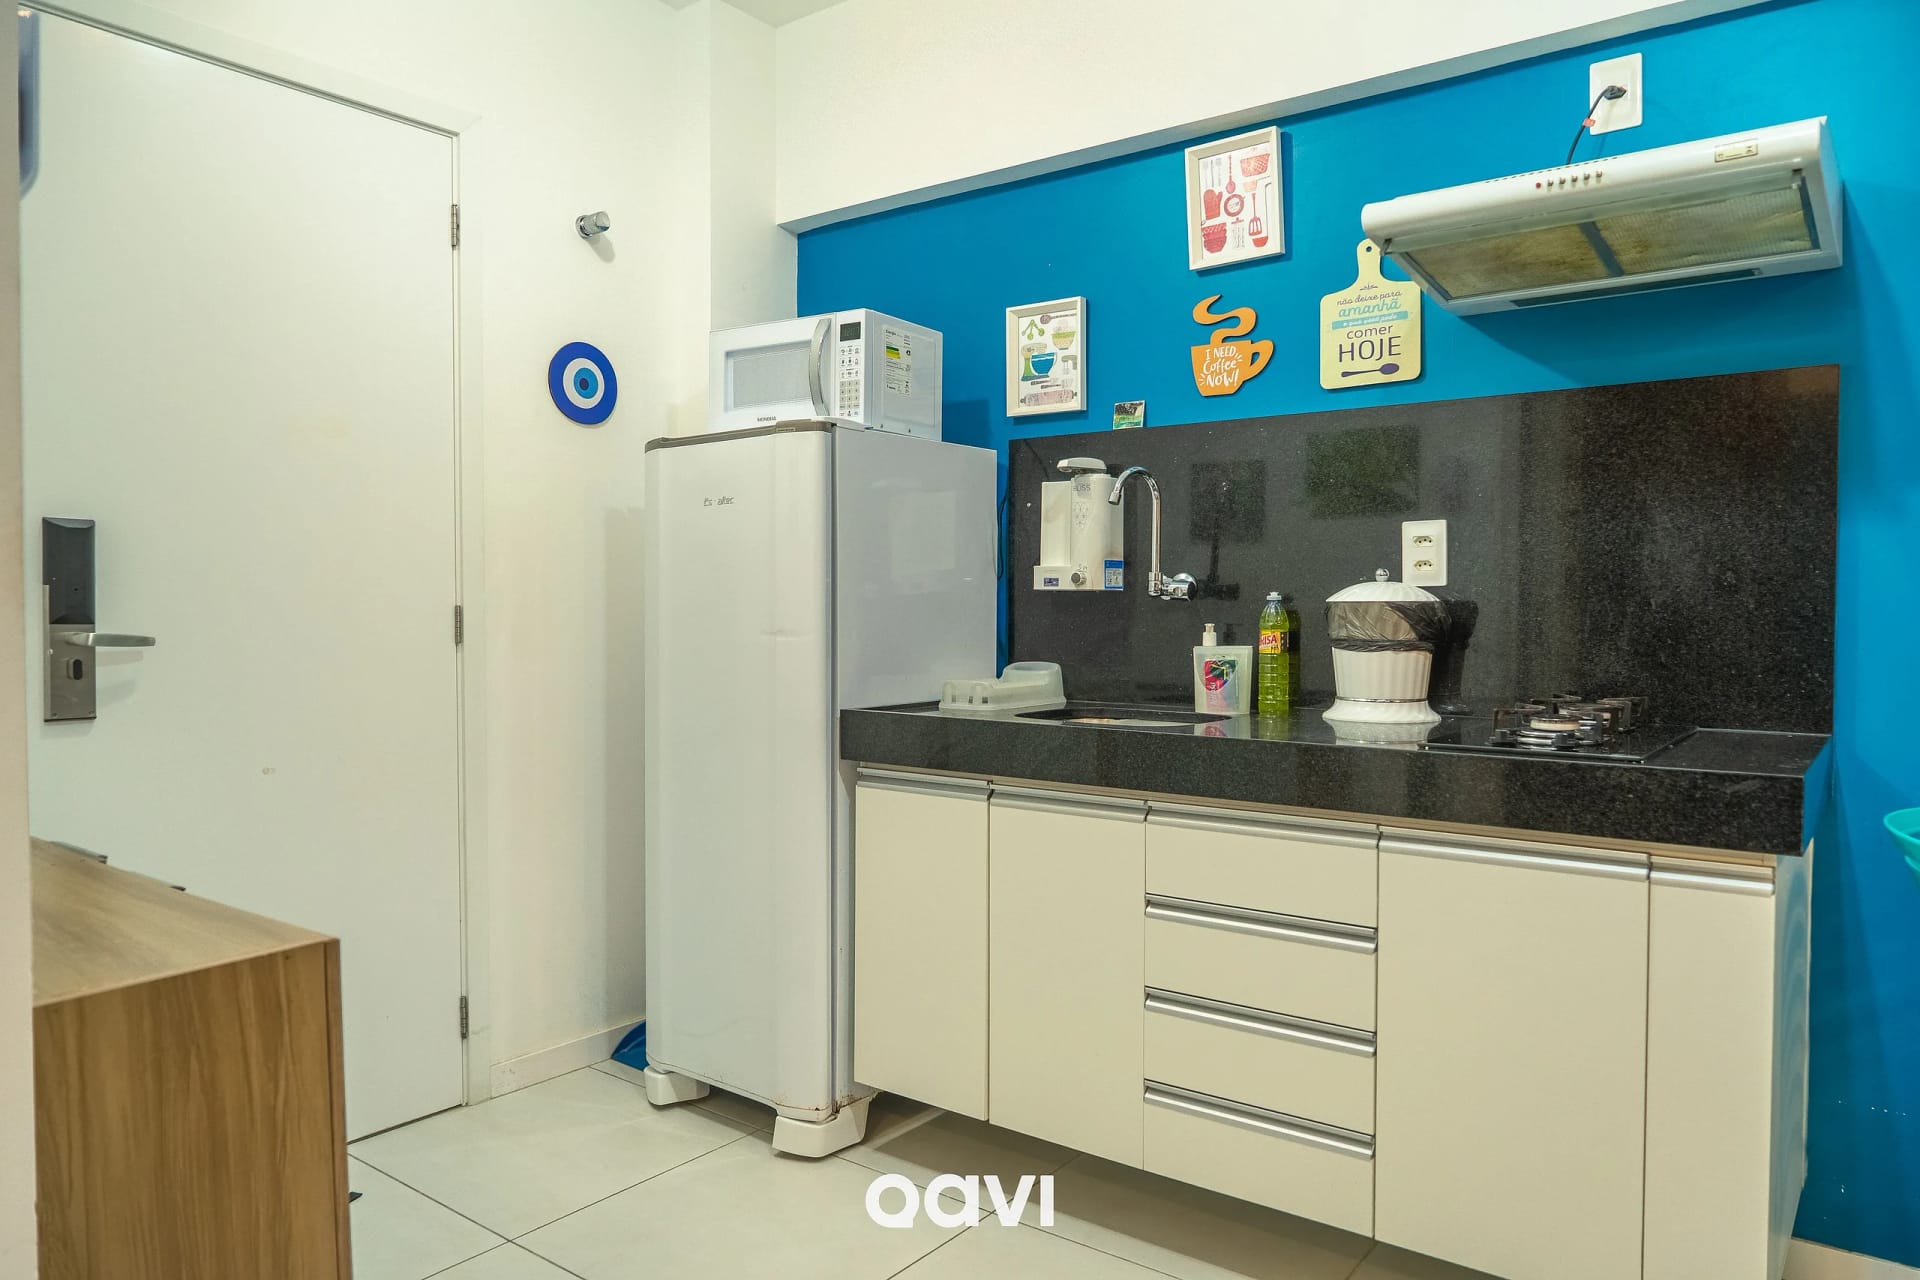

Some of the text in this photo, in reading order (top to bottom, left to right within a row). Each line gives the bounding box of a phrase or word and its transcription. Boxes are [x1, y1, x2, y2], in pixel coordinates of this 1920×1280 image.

[1355, 294, 1379, 303] deixe
[1380, 291, 1403, 300] para
[1338, 297, 1402, 318] amanhã
[1346, 325, 1393, 340] comer
[1205, 345, 1237, 361] I NEED
[1338, 335, 1402, 363] HOJE
[1203, 358, 1238, 375] Coffee
